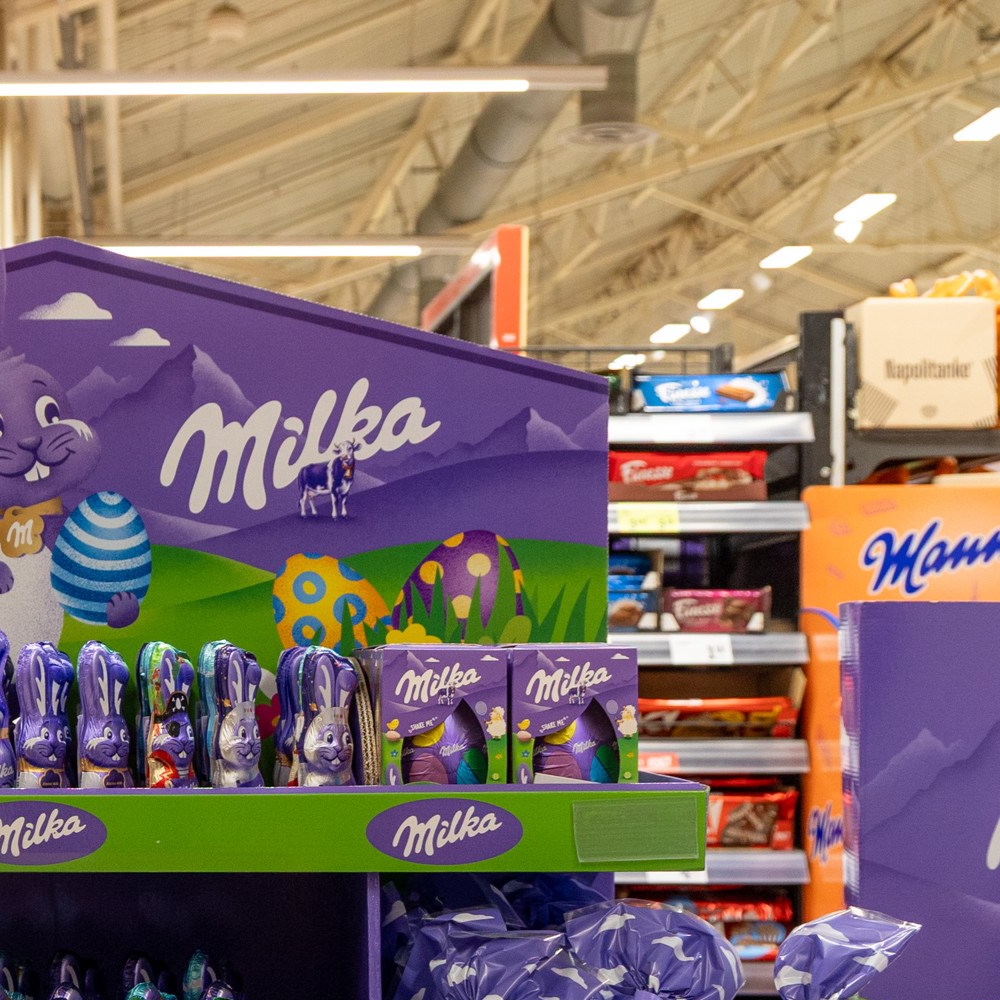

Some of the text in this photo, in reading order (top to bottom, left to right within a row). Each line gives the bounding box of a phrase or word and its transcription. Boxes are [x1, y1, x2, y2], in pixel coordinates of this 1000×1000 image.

[160, 378, 441, 516] Milka
[395, 662, 481, 703] Milka
[526, 661, 612, 703] Milka
[393, 806, 502, 857] Milka
